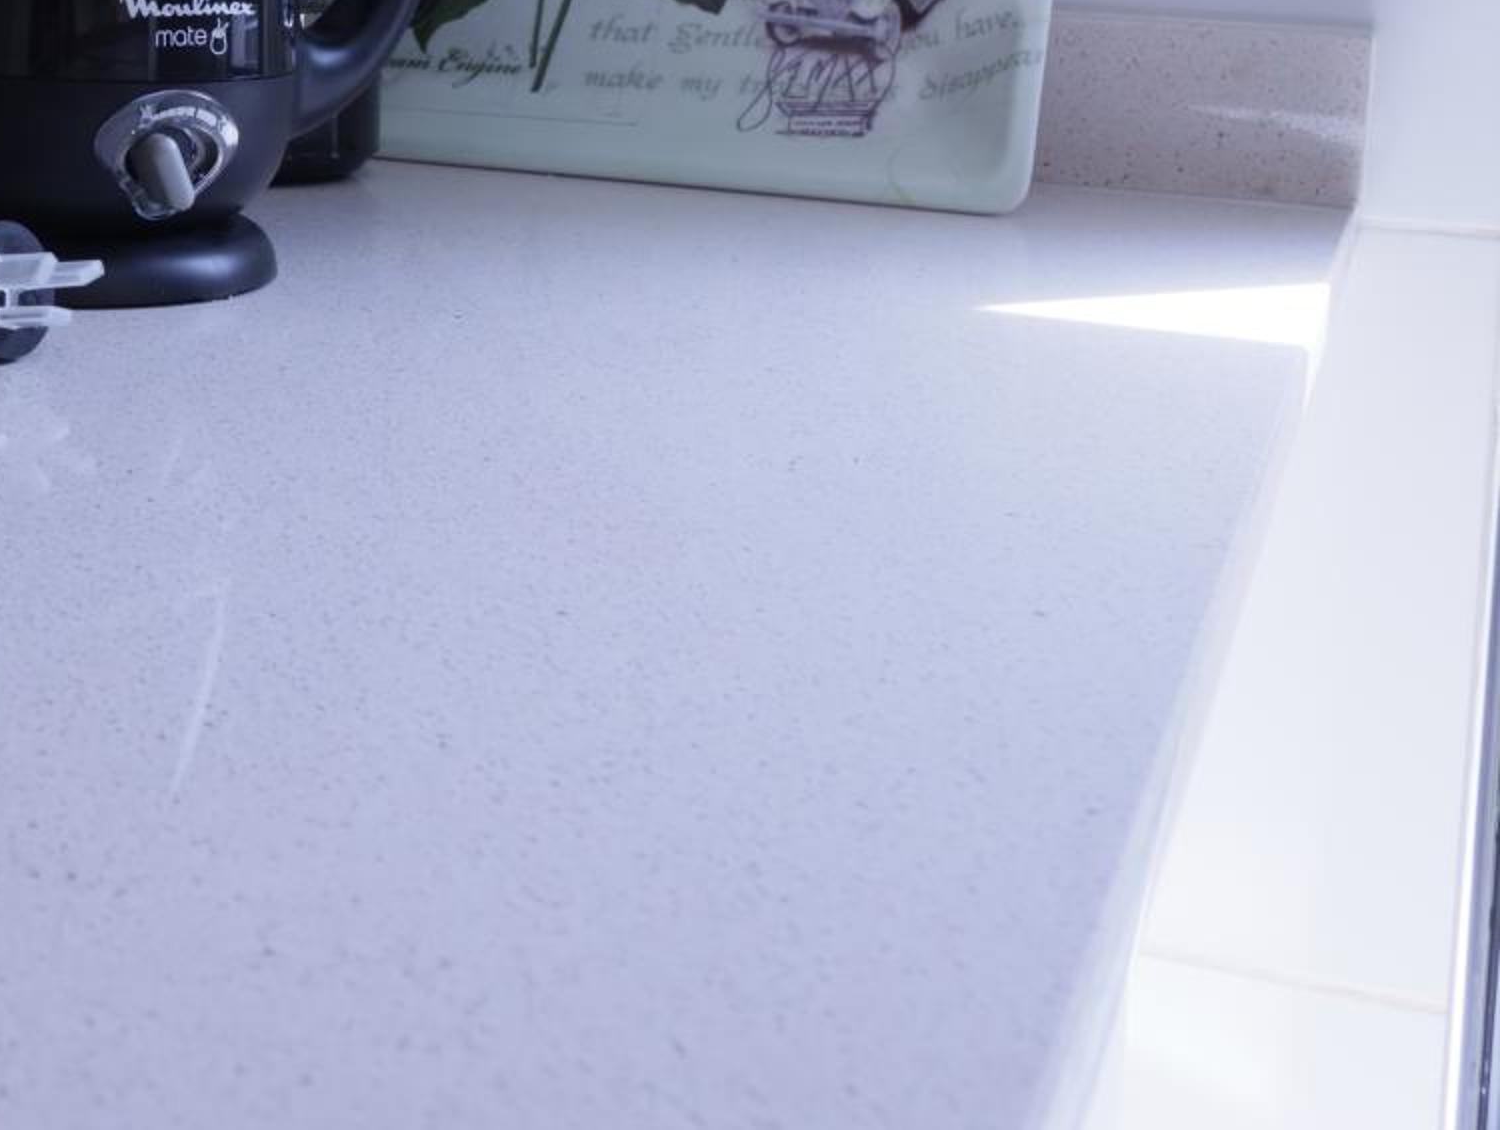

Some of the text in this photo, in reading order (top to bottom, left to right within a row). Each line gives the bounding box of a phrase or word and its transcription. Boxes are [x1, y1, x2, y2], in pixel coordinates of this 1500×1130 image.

[154, 26, 208, 48] mate
[589, 14, 657, 43] that
[584, 59, 665, 91] make
[680, 76, 724, 103] my
